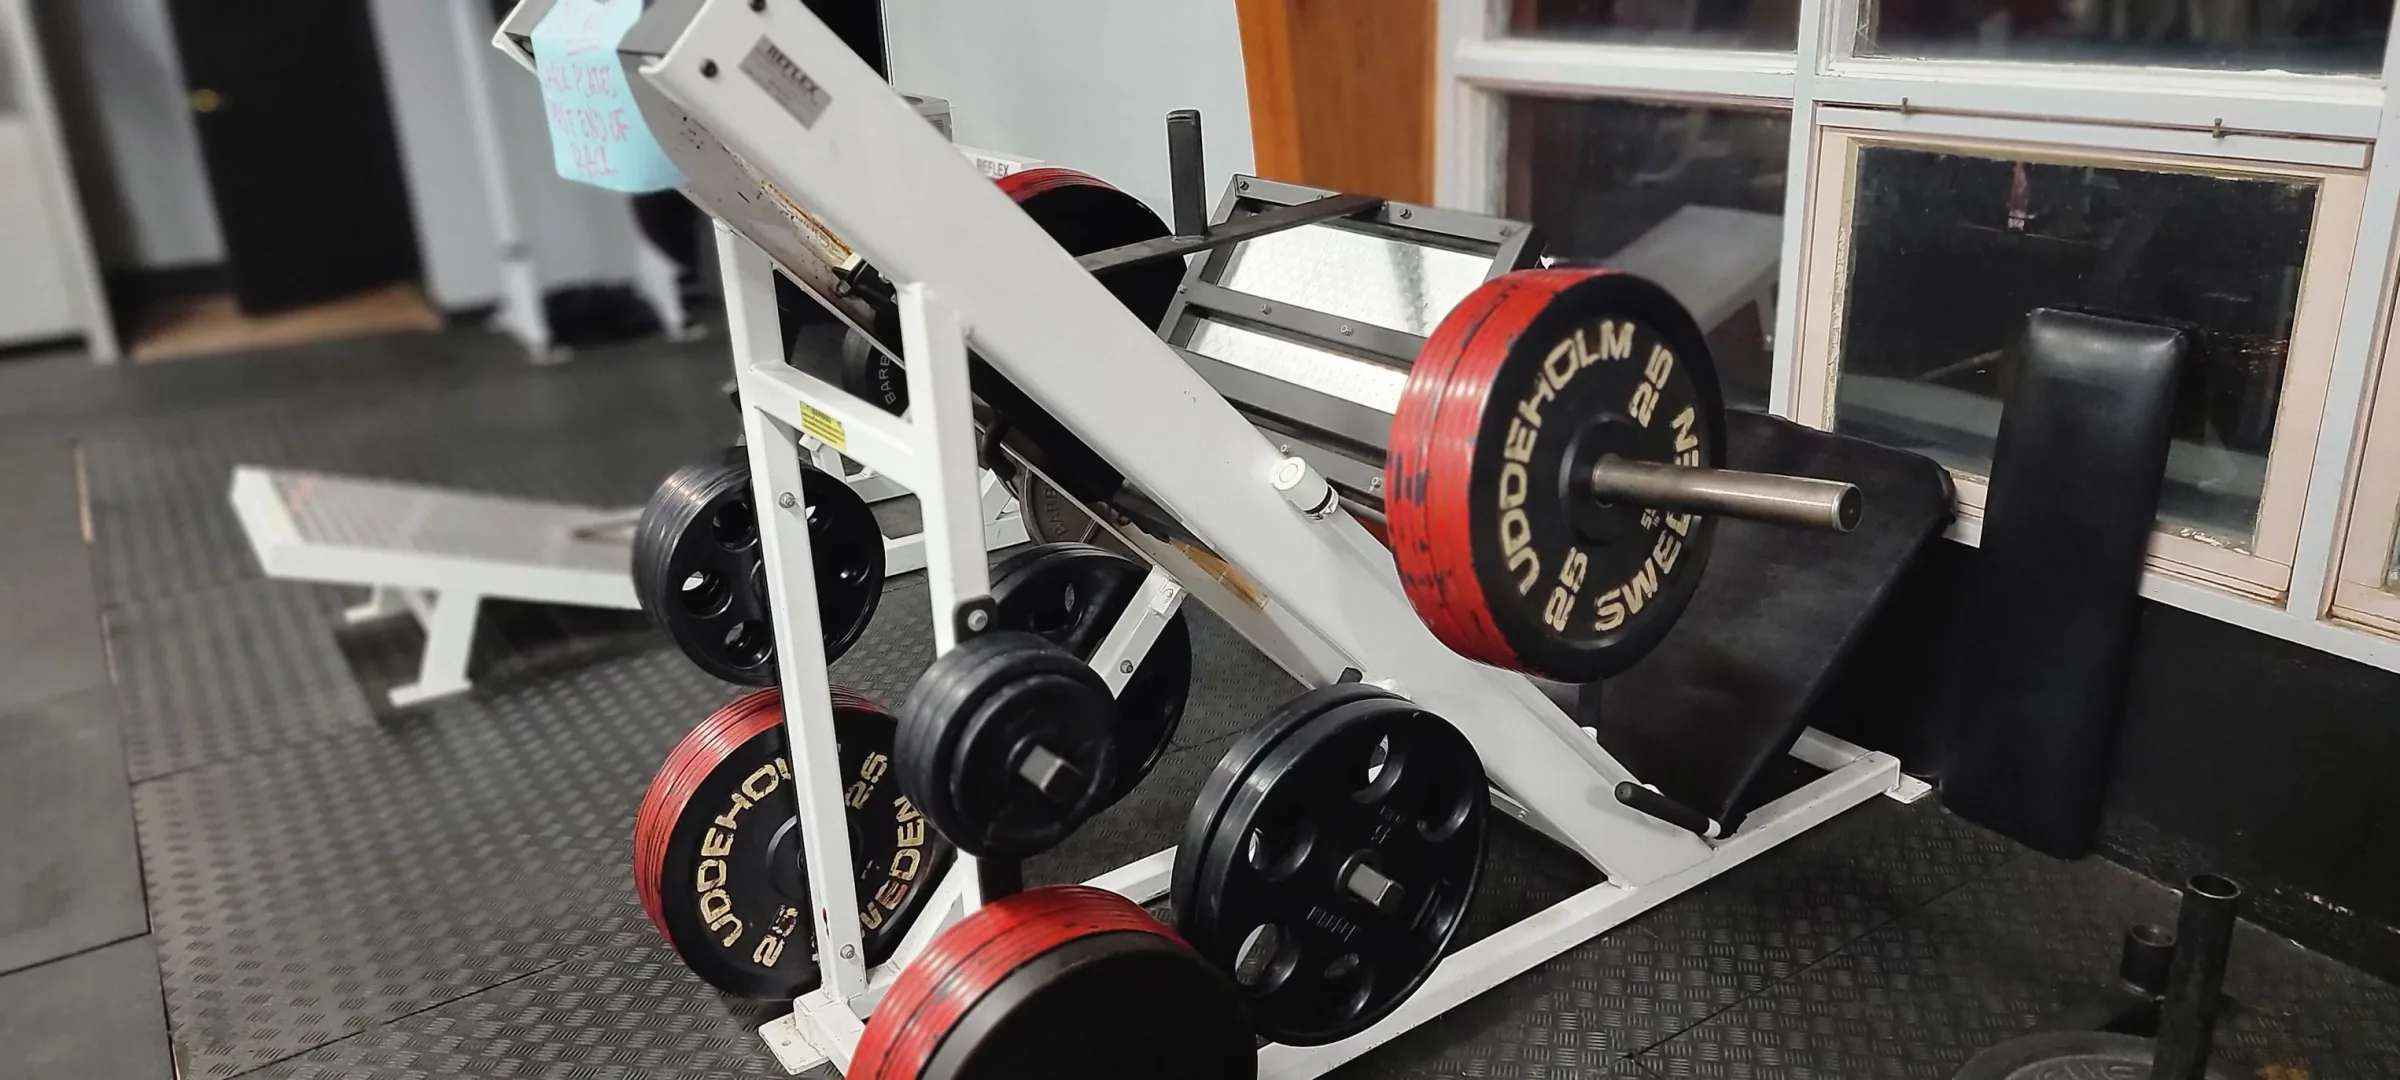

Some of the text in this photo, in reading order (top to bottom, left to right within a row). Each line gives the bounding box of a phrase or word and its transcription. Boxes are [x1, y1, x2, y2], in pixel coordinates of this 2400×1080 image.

[766, 44, 818, 101] REFLEX
[976, 158, 1009, 177] REFLEX
[1629, 344, 1674, 428] 25
[1499, 320, 1635, 596] UDDEHOLM
[1544, 547, 1588, 633] 25
[845, 751, 887, 810] 25
[697, 757, 791, 947] UDDEHOL
[753, 904, 799, 968] 25
